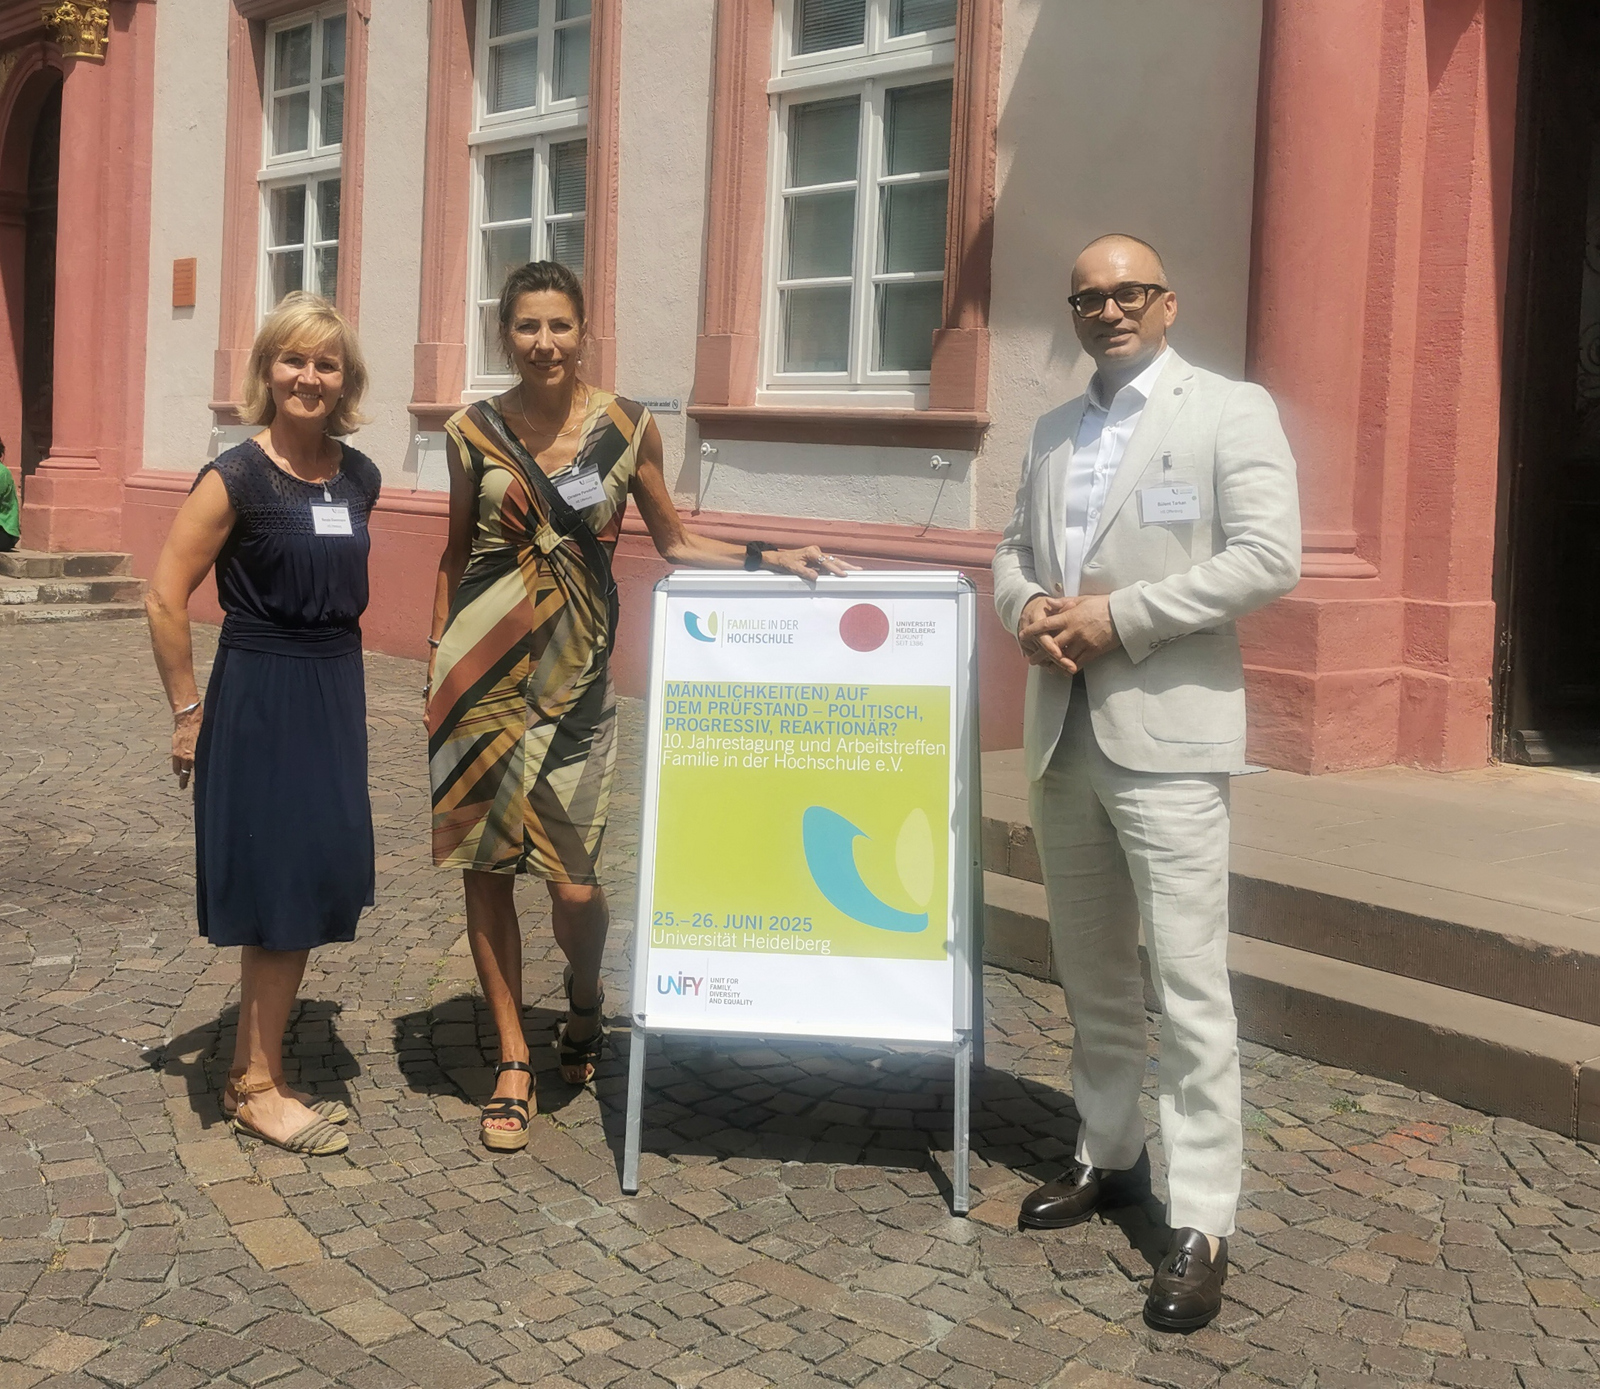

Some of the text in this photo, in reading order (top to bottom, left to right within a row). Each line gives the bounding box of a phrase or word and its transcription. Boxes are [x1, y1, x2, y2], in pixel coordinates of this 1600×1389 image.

[727, 619, 799, 631] FAMILIE IN DER
[727, 633, 794, 644] HOCHSCHULE
[666, 681, 870, 702] MÄNNLICHKEIT(EN) AUF
[666, 700, 702, 715] DEM
[708, 698, 808, 717] PRÜFSTAND
[828, 703, 923, 722] POLITISCH,
[665, 717, 898, 737] PROGRESSIV, REAKTIONÄR?
[664, 733, 946, 756] 10. Jahrestagung und Arbeitstreffen
[663, 750, 903, 772] Familie in der Hochschule e.V.
[653, 911, 813, 932] 25.–26. JUNI 2025
[652, 928, 831, 955] Universität Heidelberg
